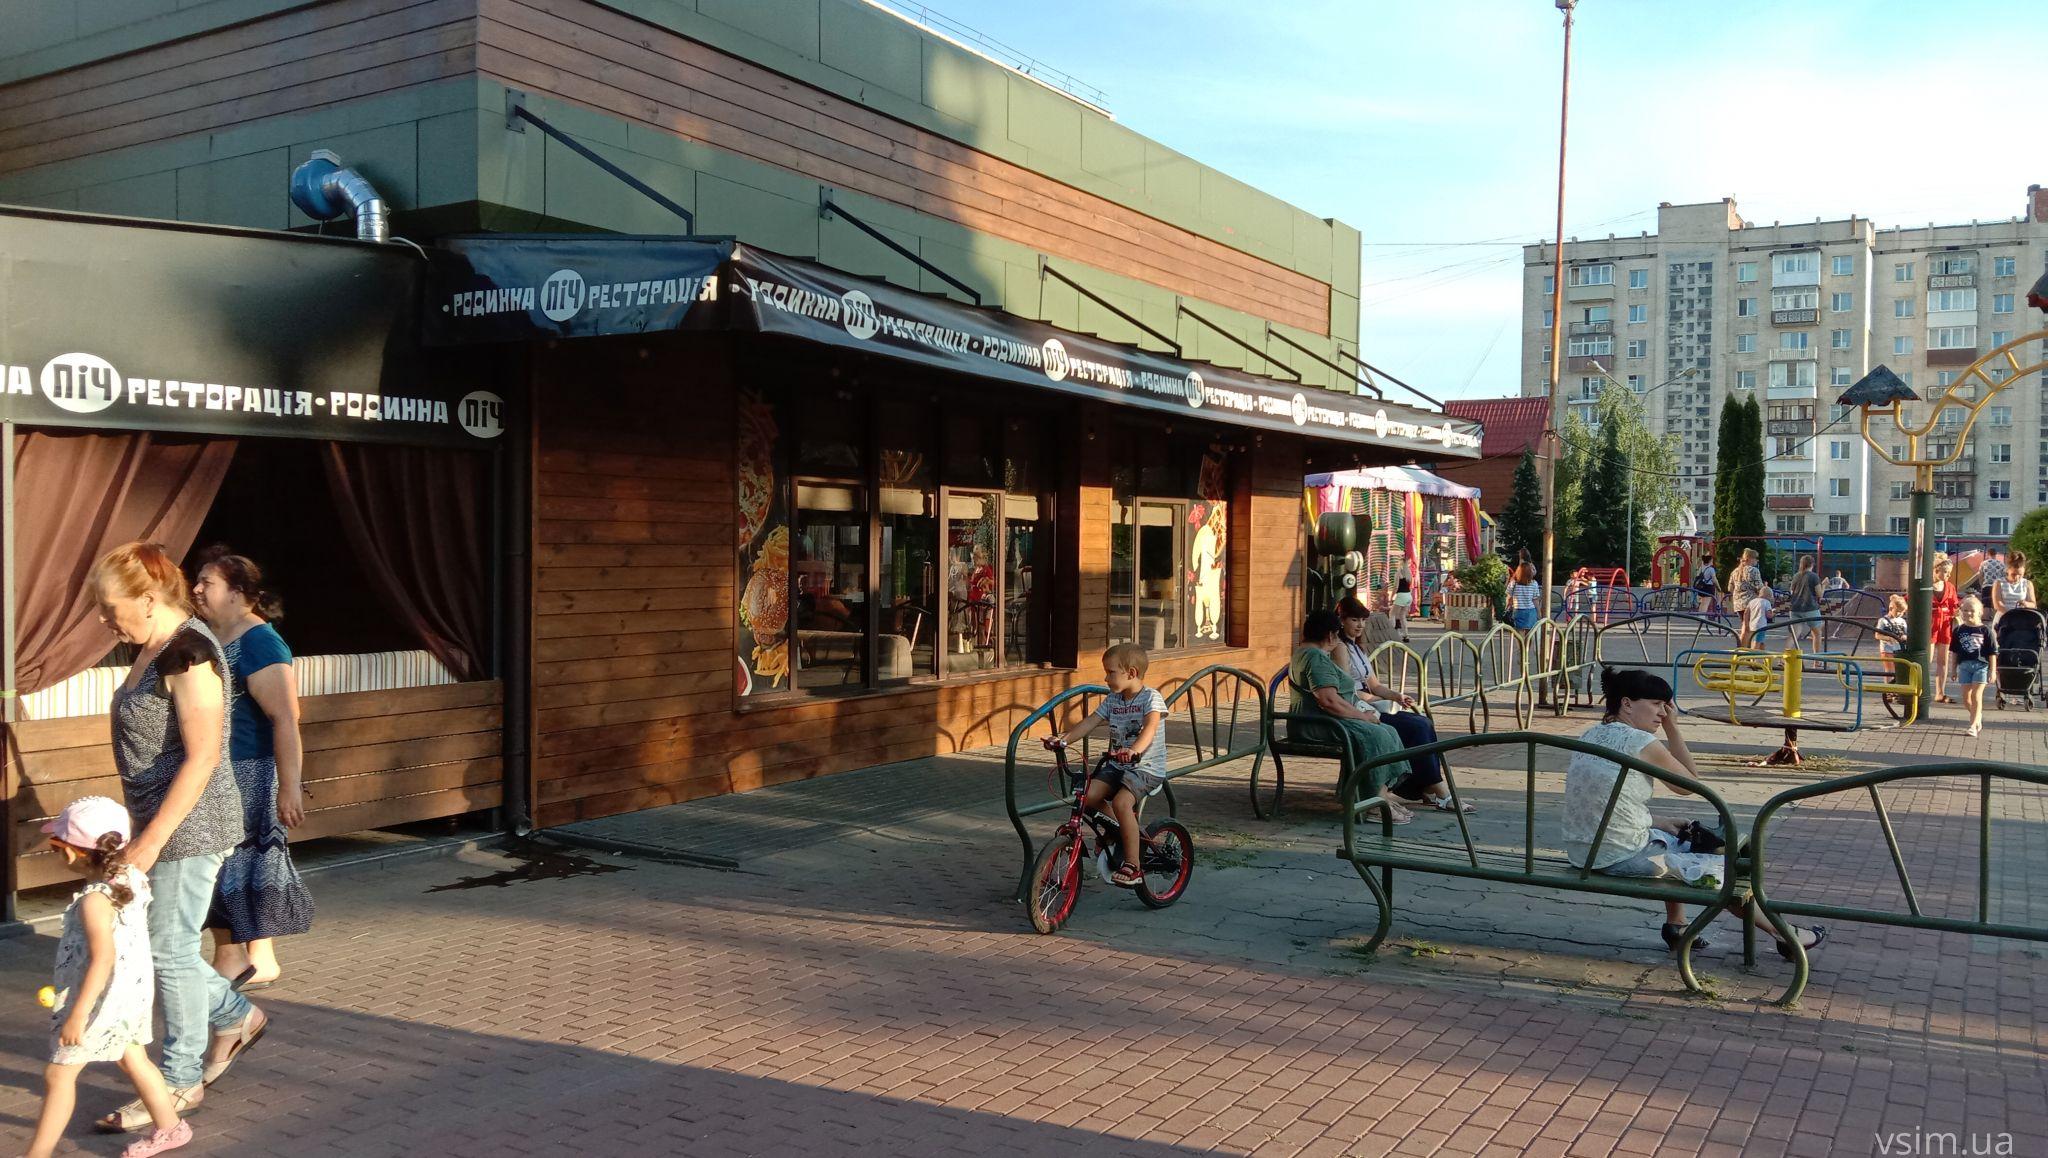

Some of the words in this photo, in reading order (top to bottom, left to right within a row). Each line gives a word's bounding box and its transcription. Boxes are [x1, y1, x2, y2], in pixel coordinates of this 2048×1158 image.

[453, 287, 535, 317] РОДИННА
[746, 277, 840, 322] РОДИННА
[982, 335, 1042, 367] РОДИННА
[1140, 372, 1185, 397] РОДИННА
[330, 391, 449, 424] РОДИННА
